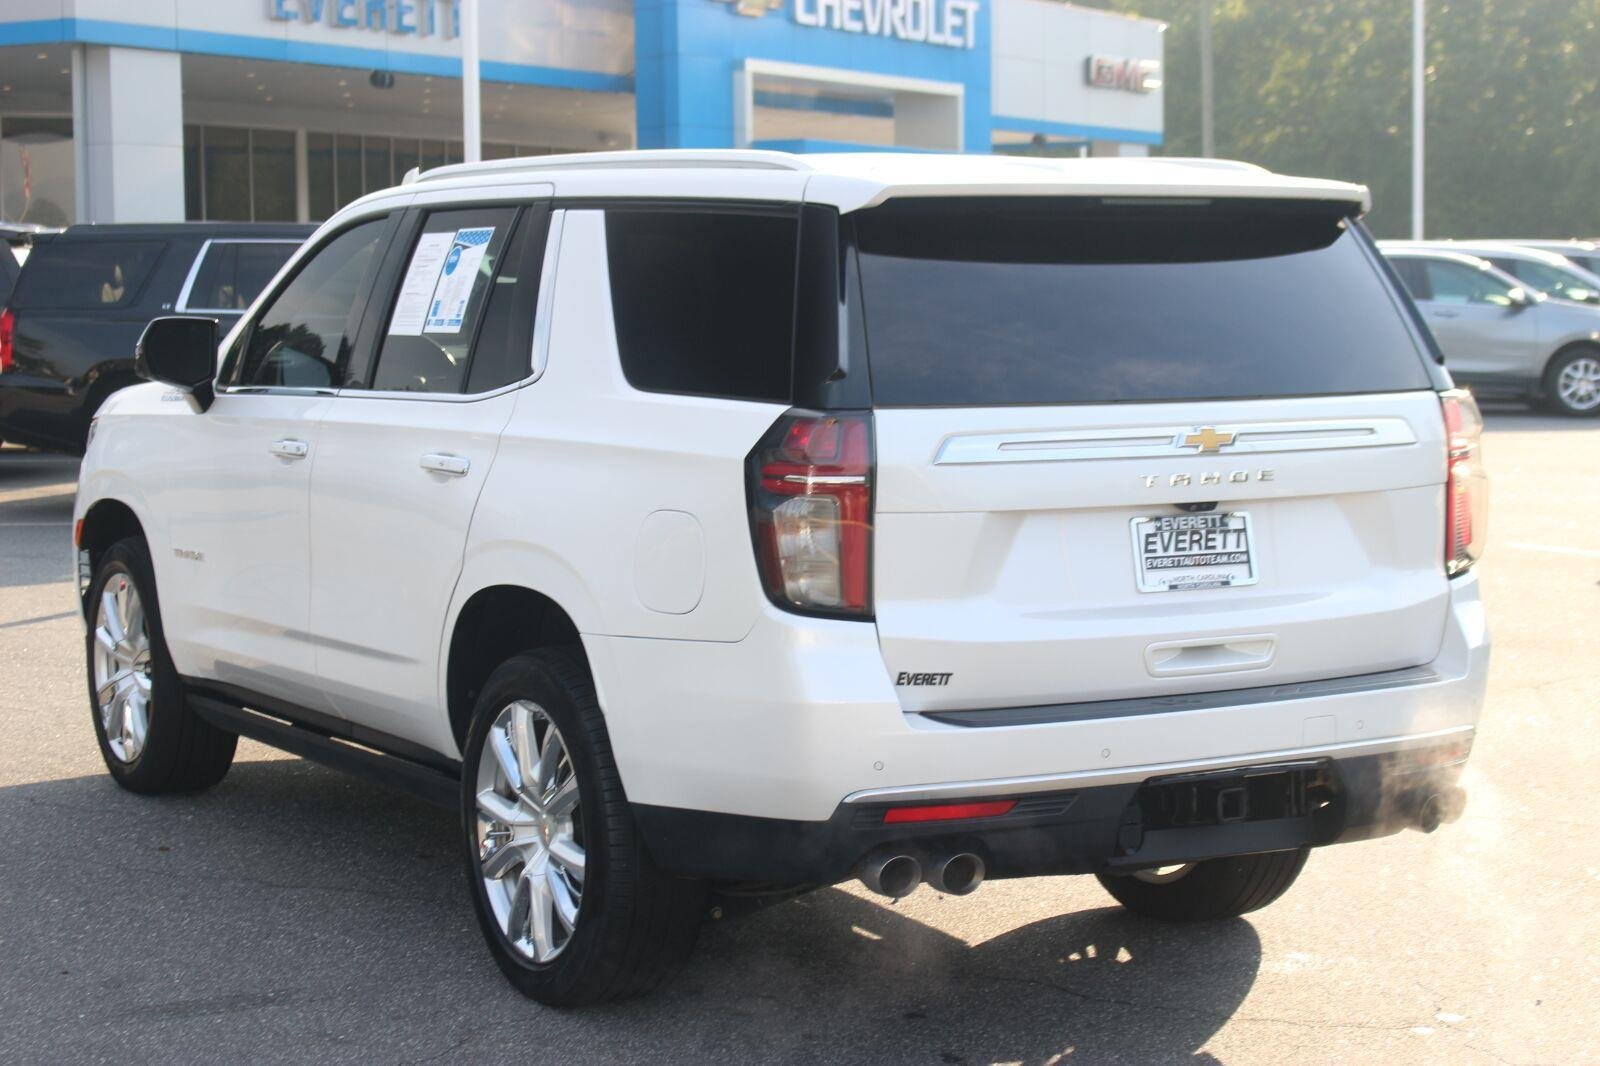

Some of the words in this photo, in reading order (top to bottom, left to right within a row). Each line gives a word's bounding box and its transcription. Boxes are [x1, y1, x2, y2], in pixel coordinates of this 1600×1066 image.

[794, 0, 978, 49] CHEVROLET
[1141, 469, 1274, 487] TAHOE
[1161, 514, 1223, 531] EVERETT
[1144, 528, 1246, 554] EVERETT
[1146, 552, 1248, 569] EVERETTAUTOTEAM.COM
[896, 671, 953, 686] EVERETT
